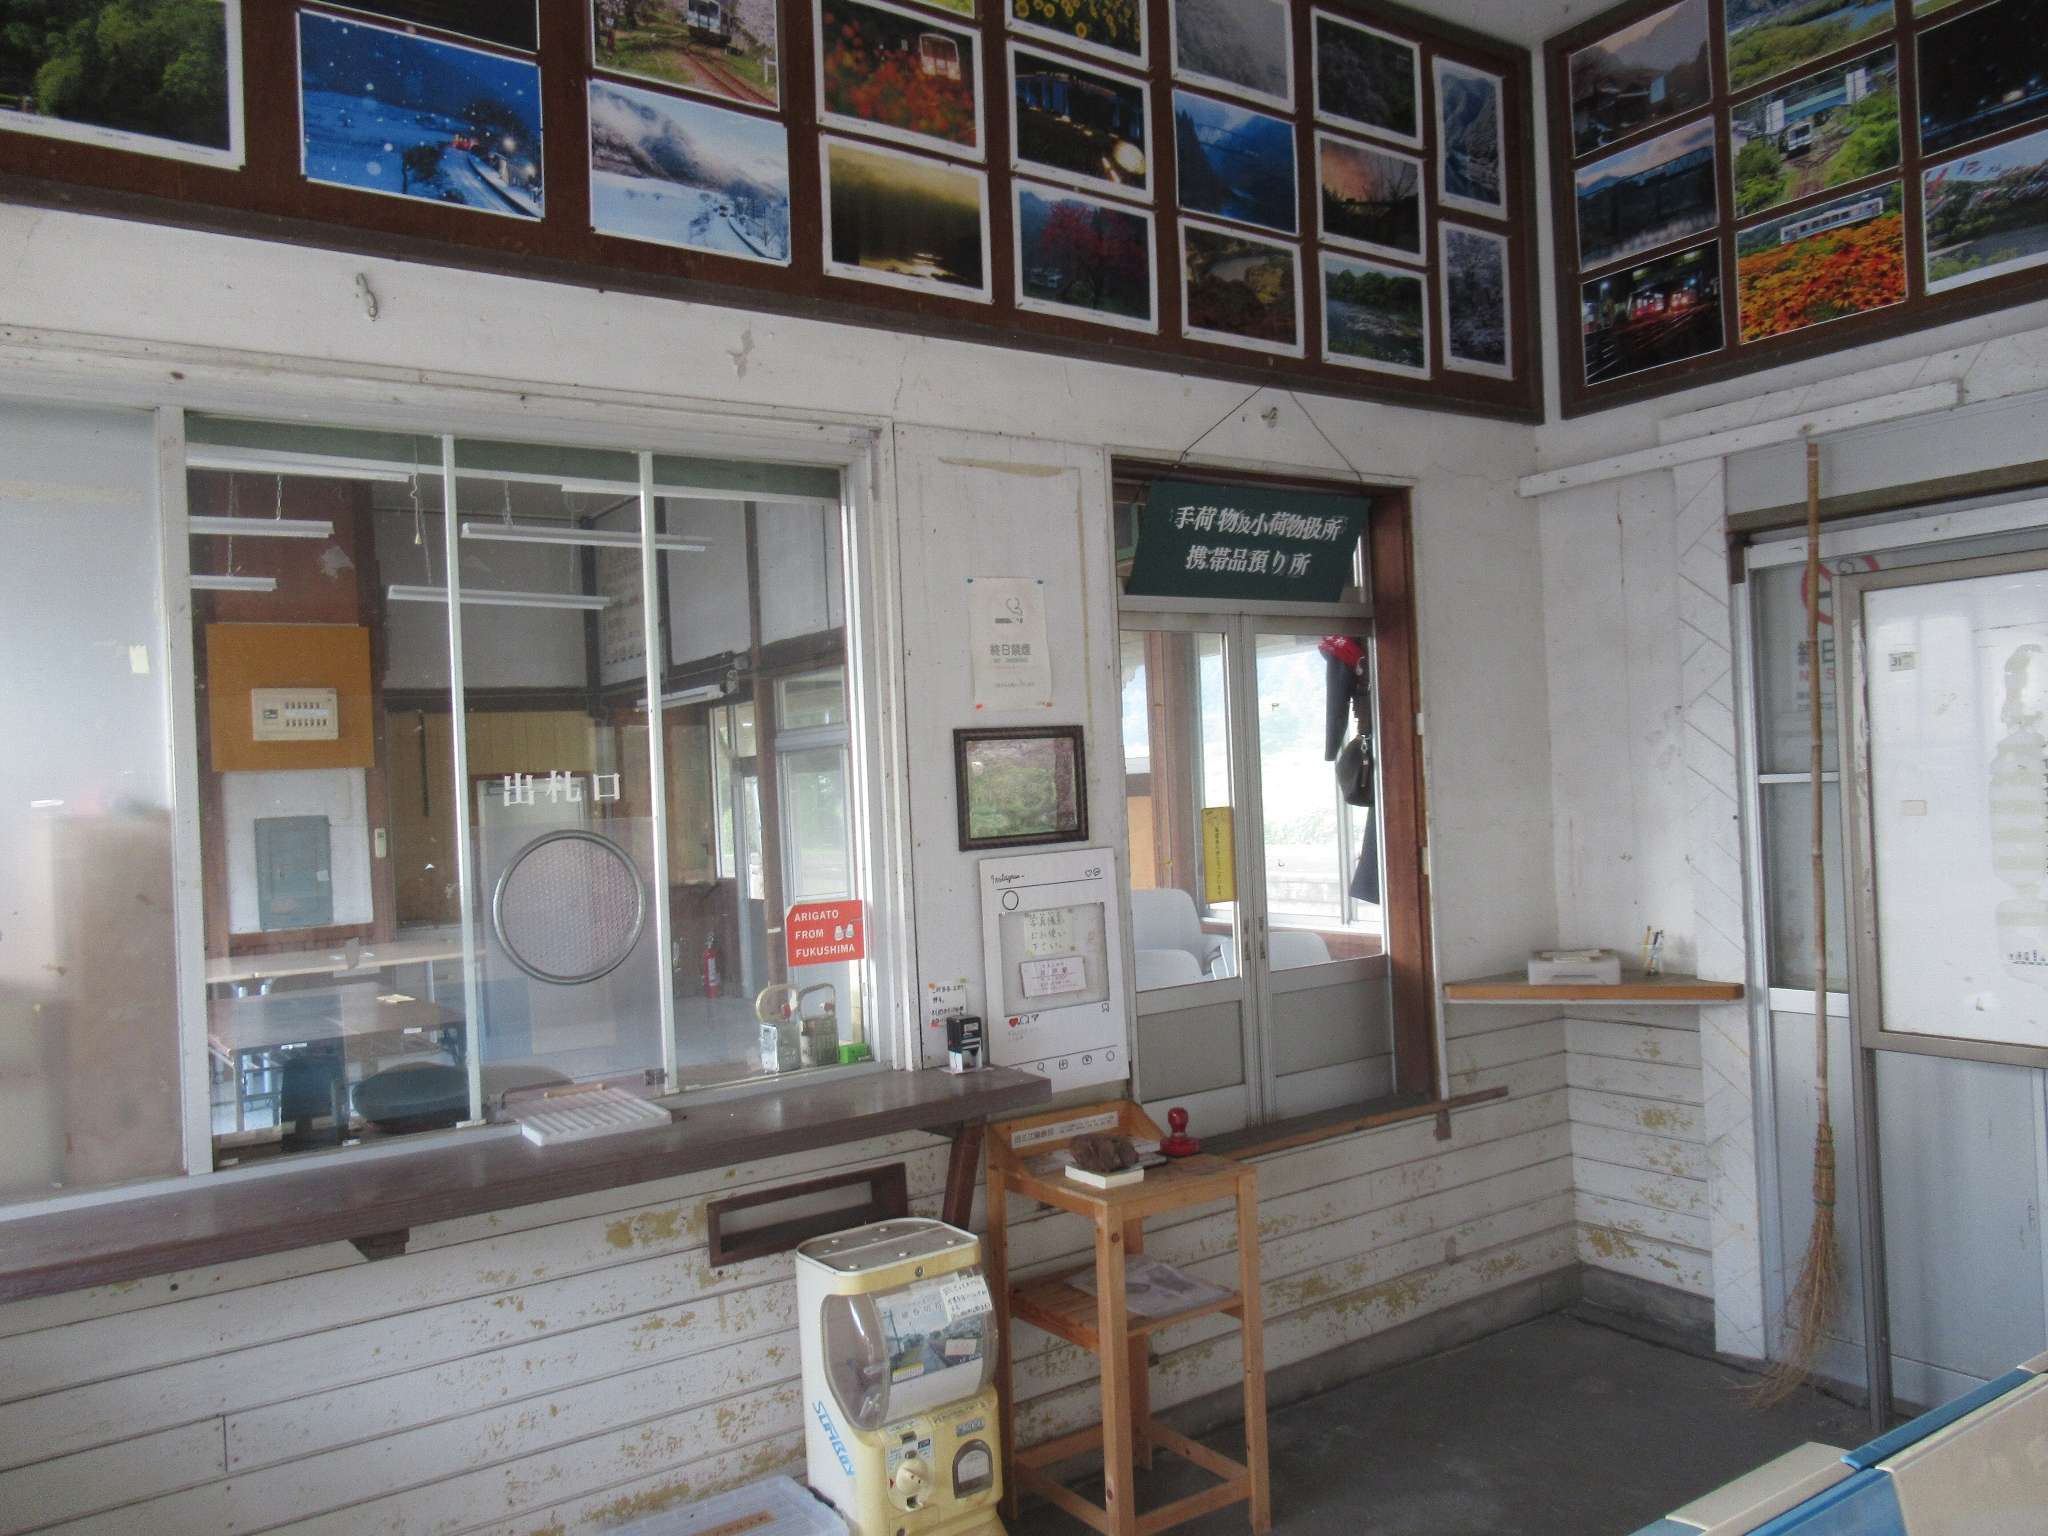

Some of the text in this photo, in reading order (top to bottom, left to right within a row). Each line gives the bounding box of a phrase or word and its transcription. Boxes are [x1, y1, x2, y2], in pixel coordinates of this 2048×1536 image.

[1174, 505, 1344, 542] 手荷物及小荷物扱所
[1185, 544, 1312, 576] 携帯品預り所
[503, 770, 621, 807] 出札口
[794, 909, 839, 923] ARIGATO
[795, 928, 824, 941] FROM
[795, 943, 856, 958] FUKUSHIMA
